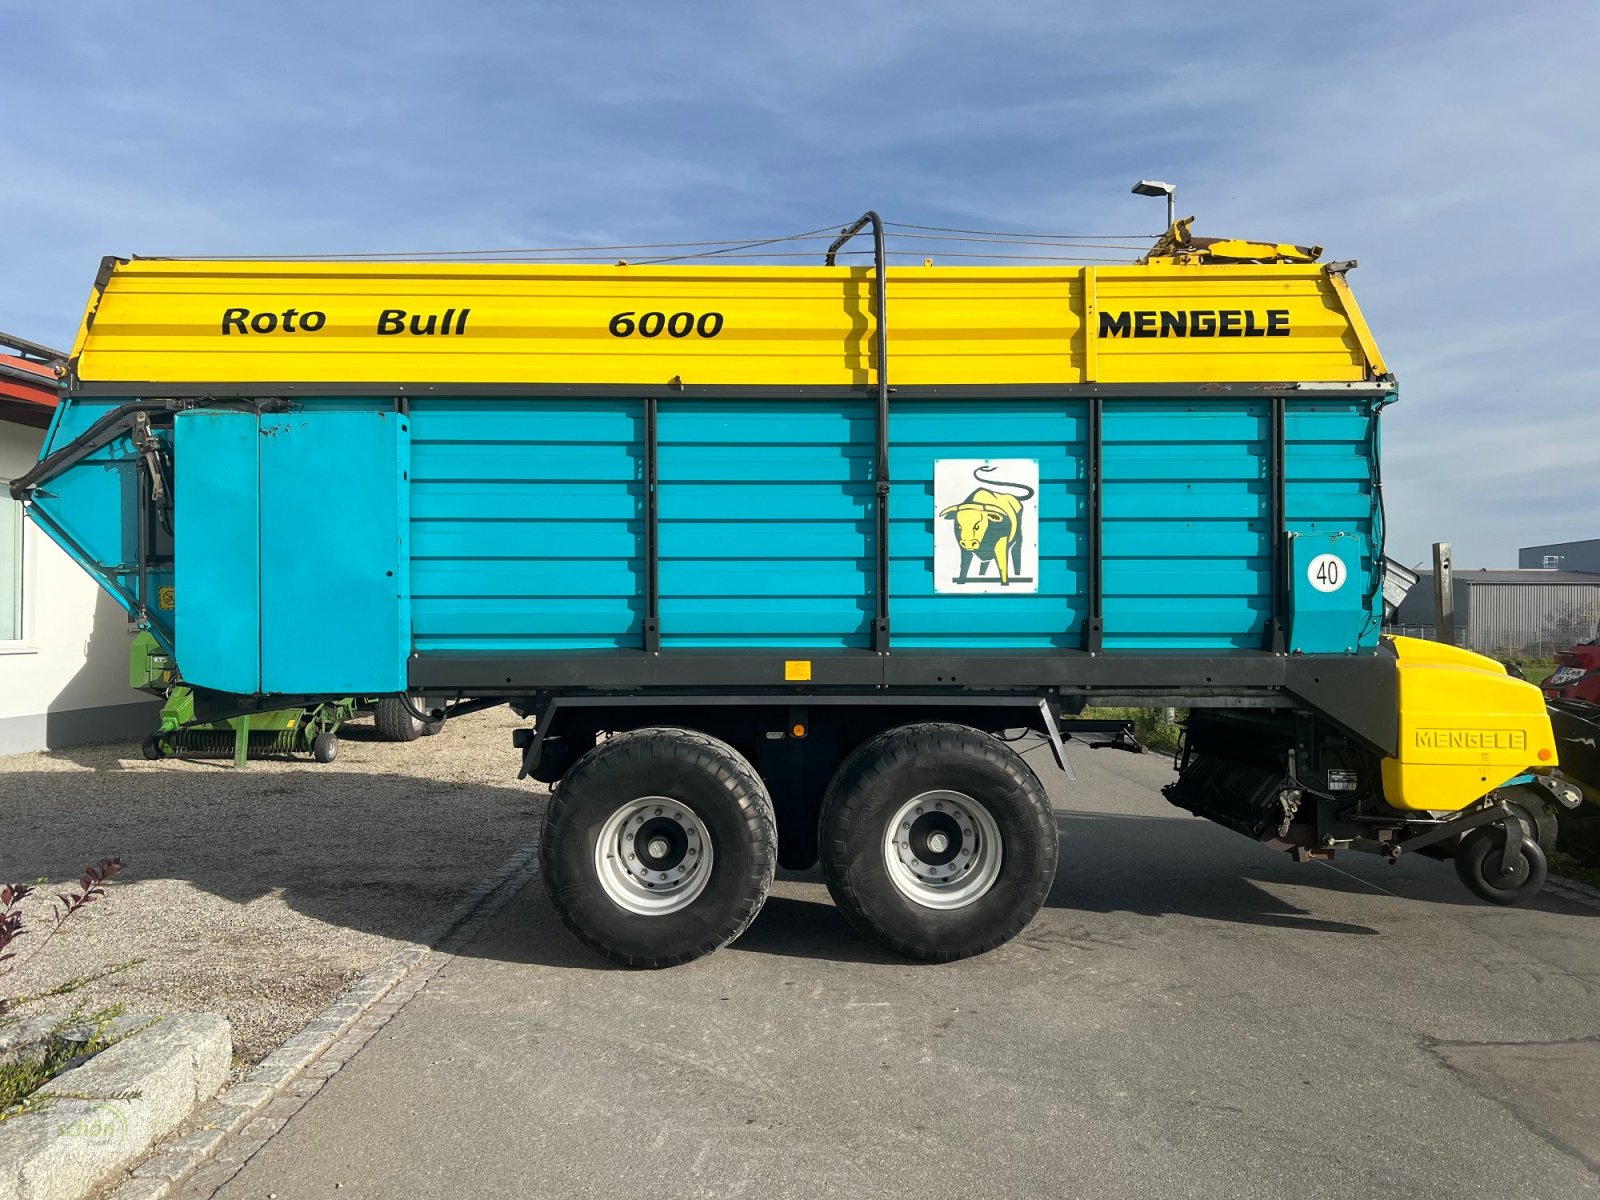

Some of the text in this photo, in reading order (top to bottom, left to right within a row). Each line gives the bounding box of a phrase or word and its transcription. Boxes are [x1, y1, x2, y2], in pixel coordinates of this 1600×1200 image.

[221, 307, 724, 339] Roto Bull 6000
[1098, 308, 1291, 339] MENGELE
[1316, 560, 1339, 585] 40
[1415, 730, 1524, 750] MENGELE
